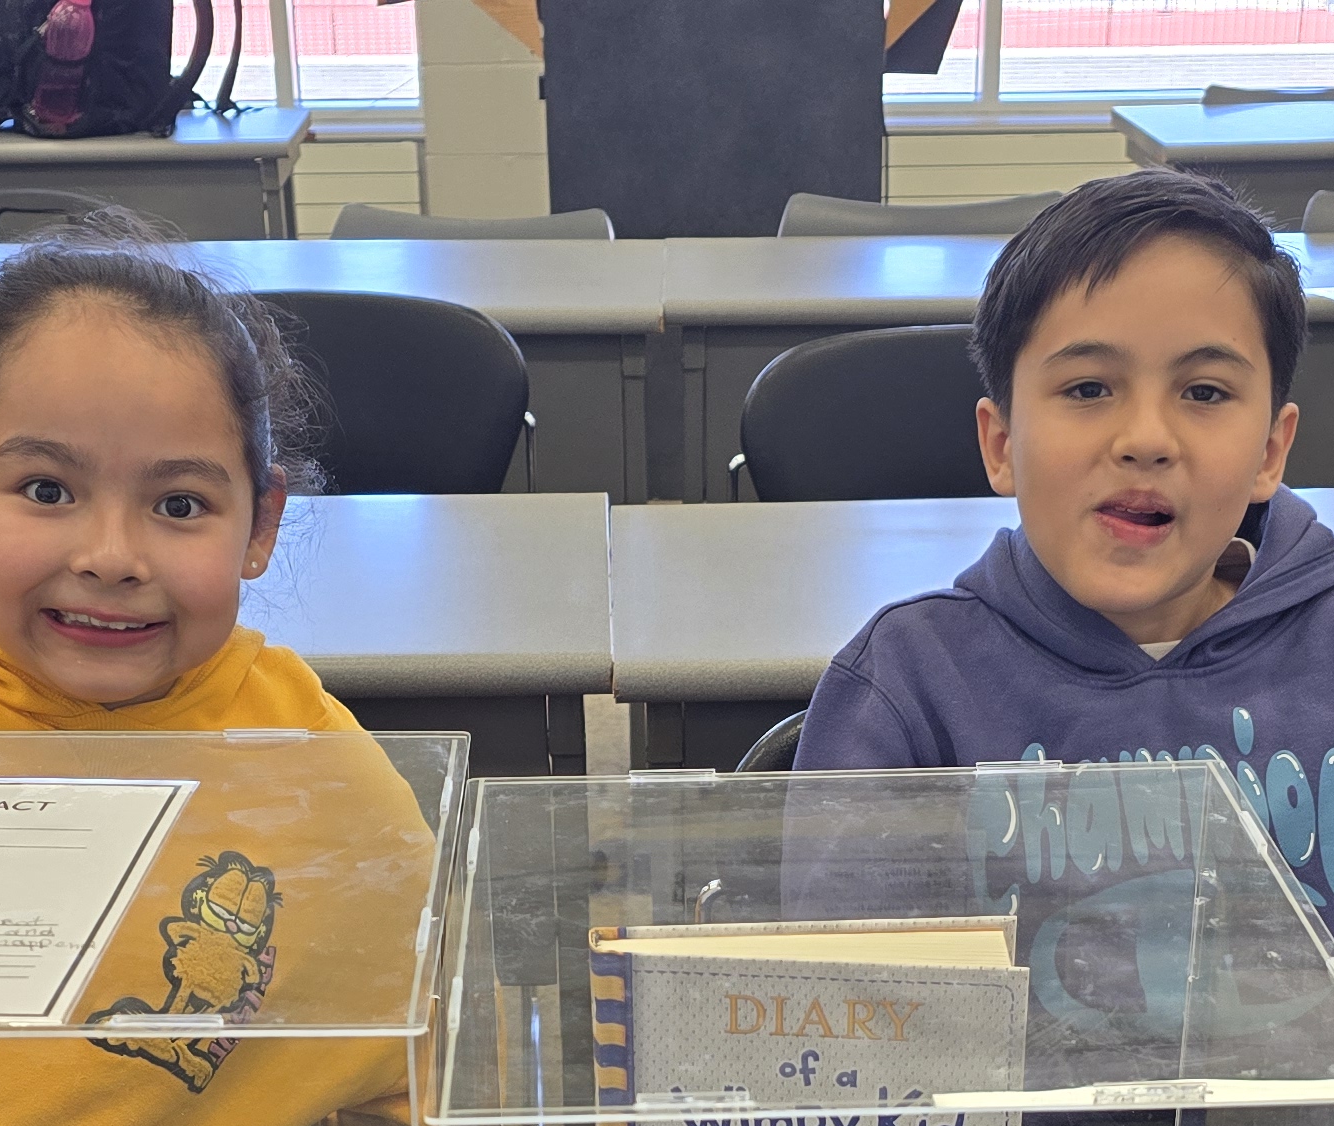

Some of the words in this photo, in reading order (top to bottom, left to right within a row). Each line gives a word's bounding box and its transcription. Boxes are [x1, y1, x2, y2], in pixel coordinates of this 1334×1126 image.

[724, 993, 925, 1042] DIARY
[778, 1049, 820, 1087] of
[835, 1069, 858, 1088] a
